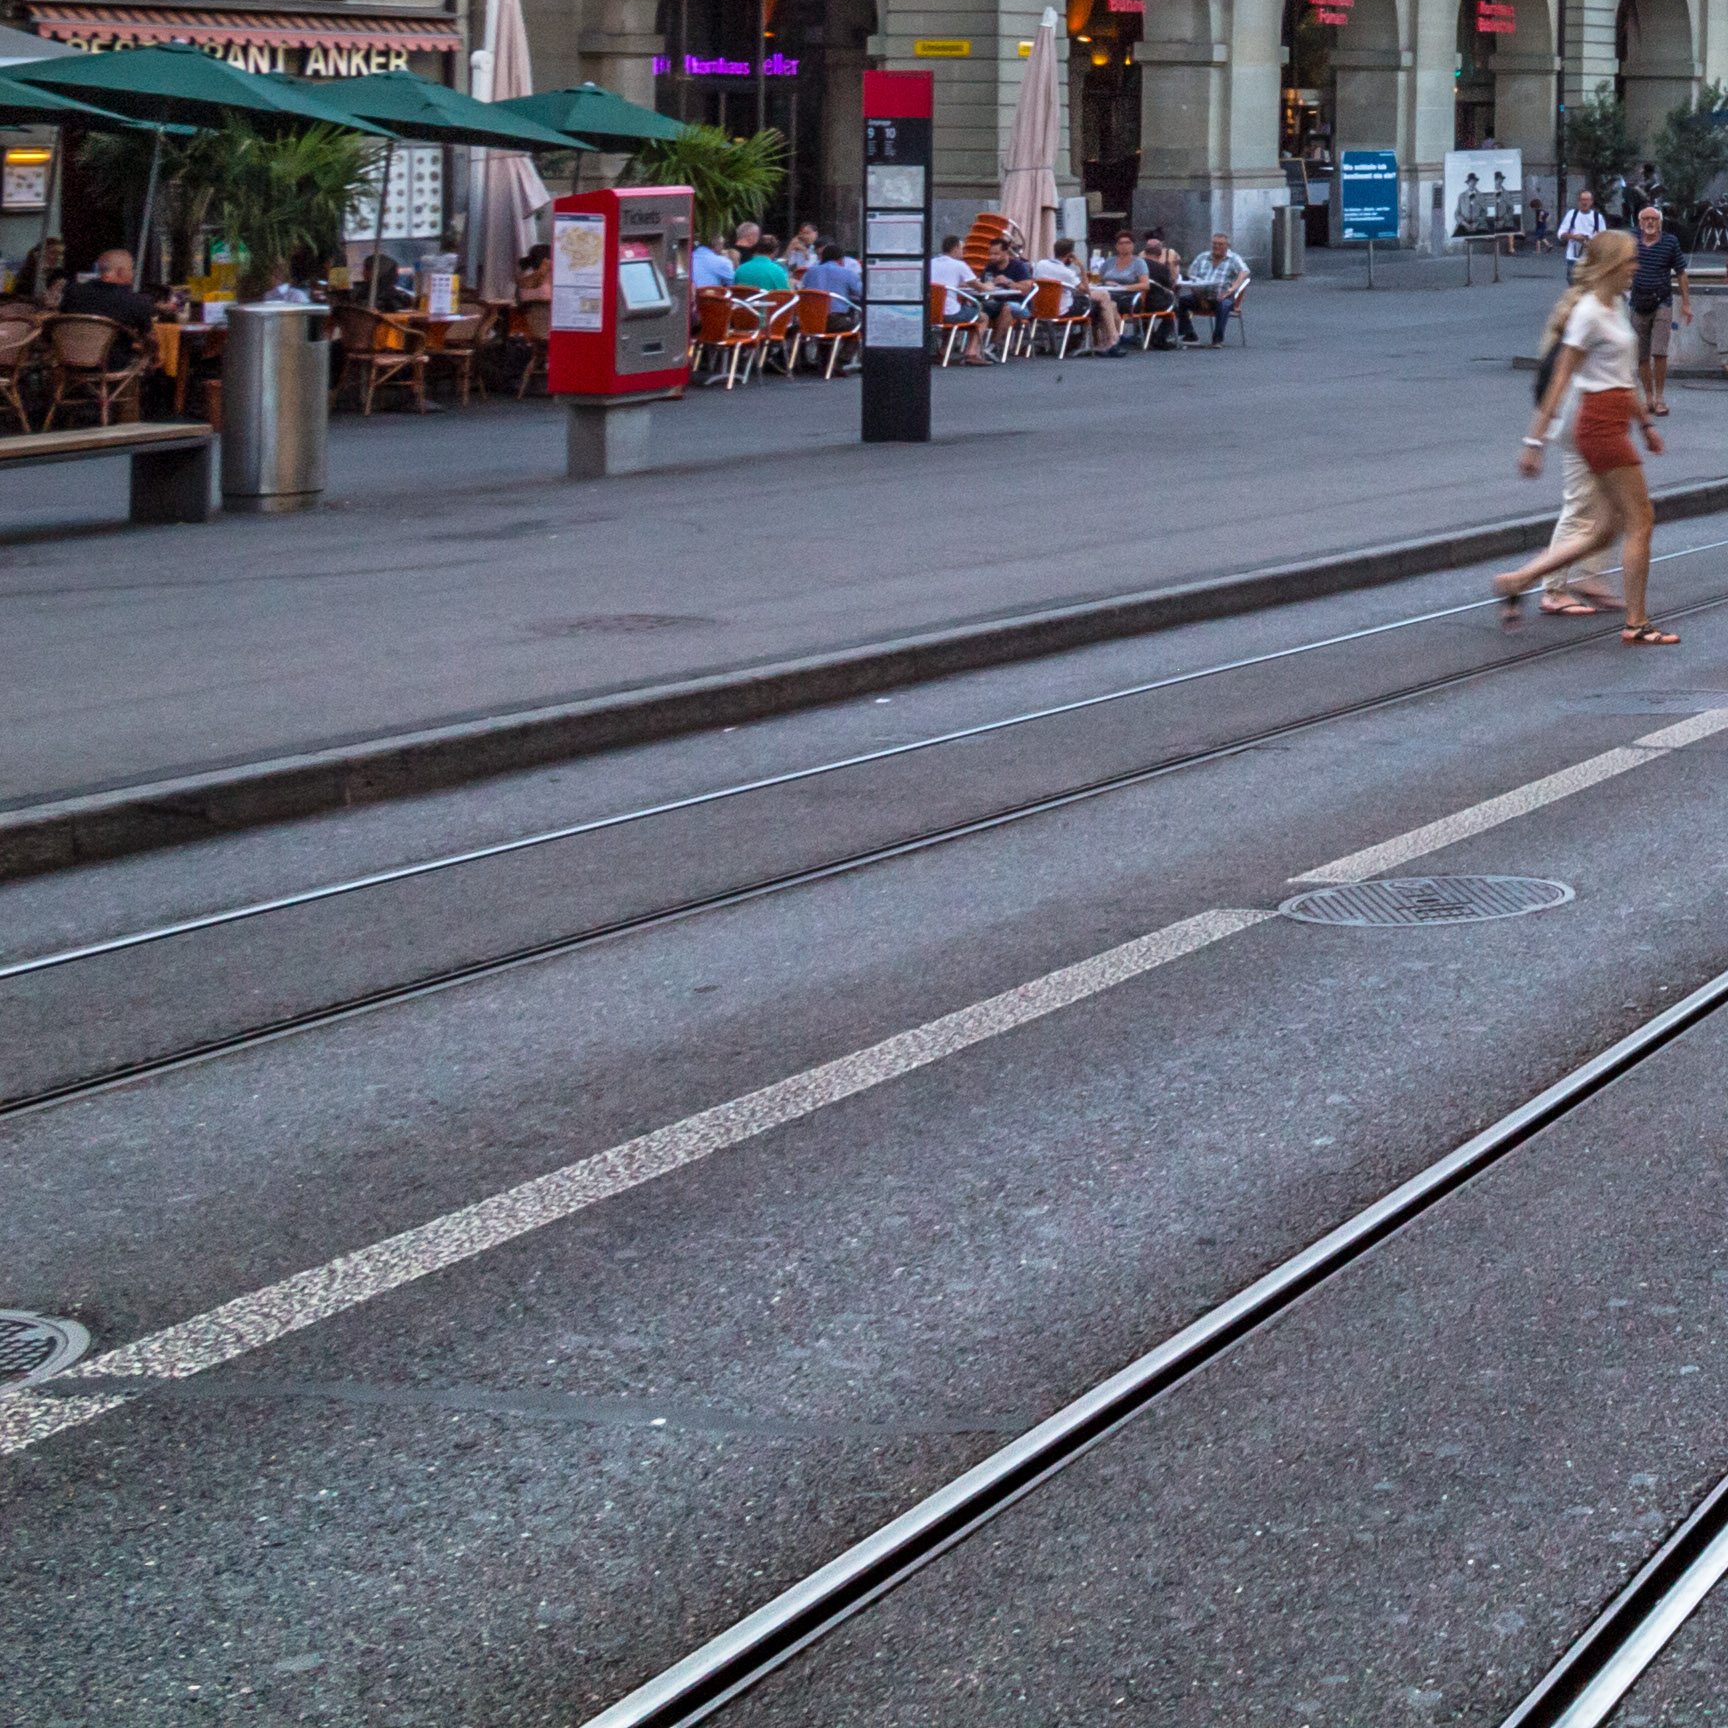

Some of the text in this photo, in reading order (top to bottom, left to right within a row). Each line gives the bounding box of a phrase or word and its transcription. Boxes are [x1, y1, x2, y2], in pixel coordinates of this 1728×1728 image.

[304, 45, 409, 77] ANKER
[867, 127, 897, 139] 9 10
